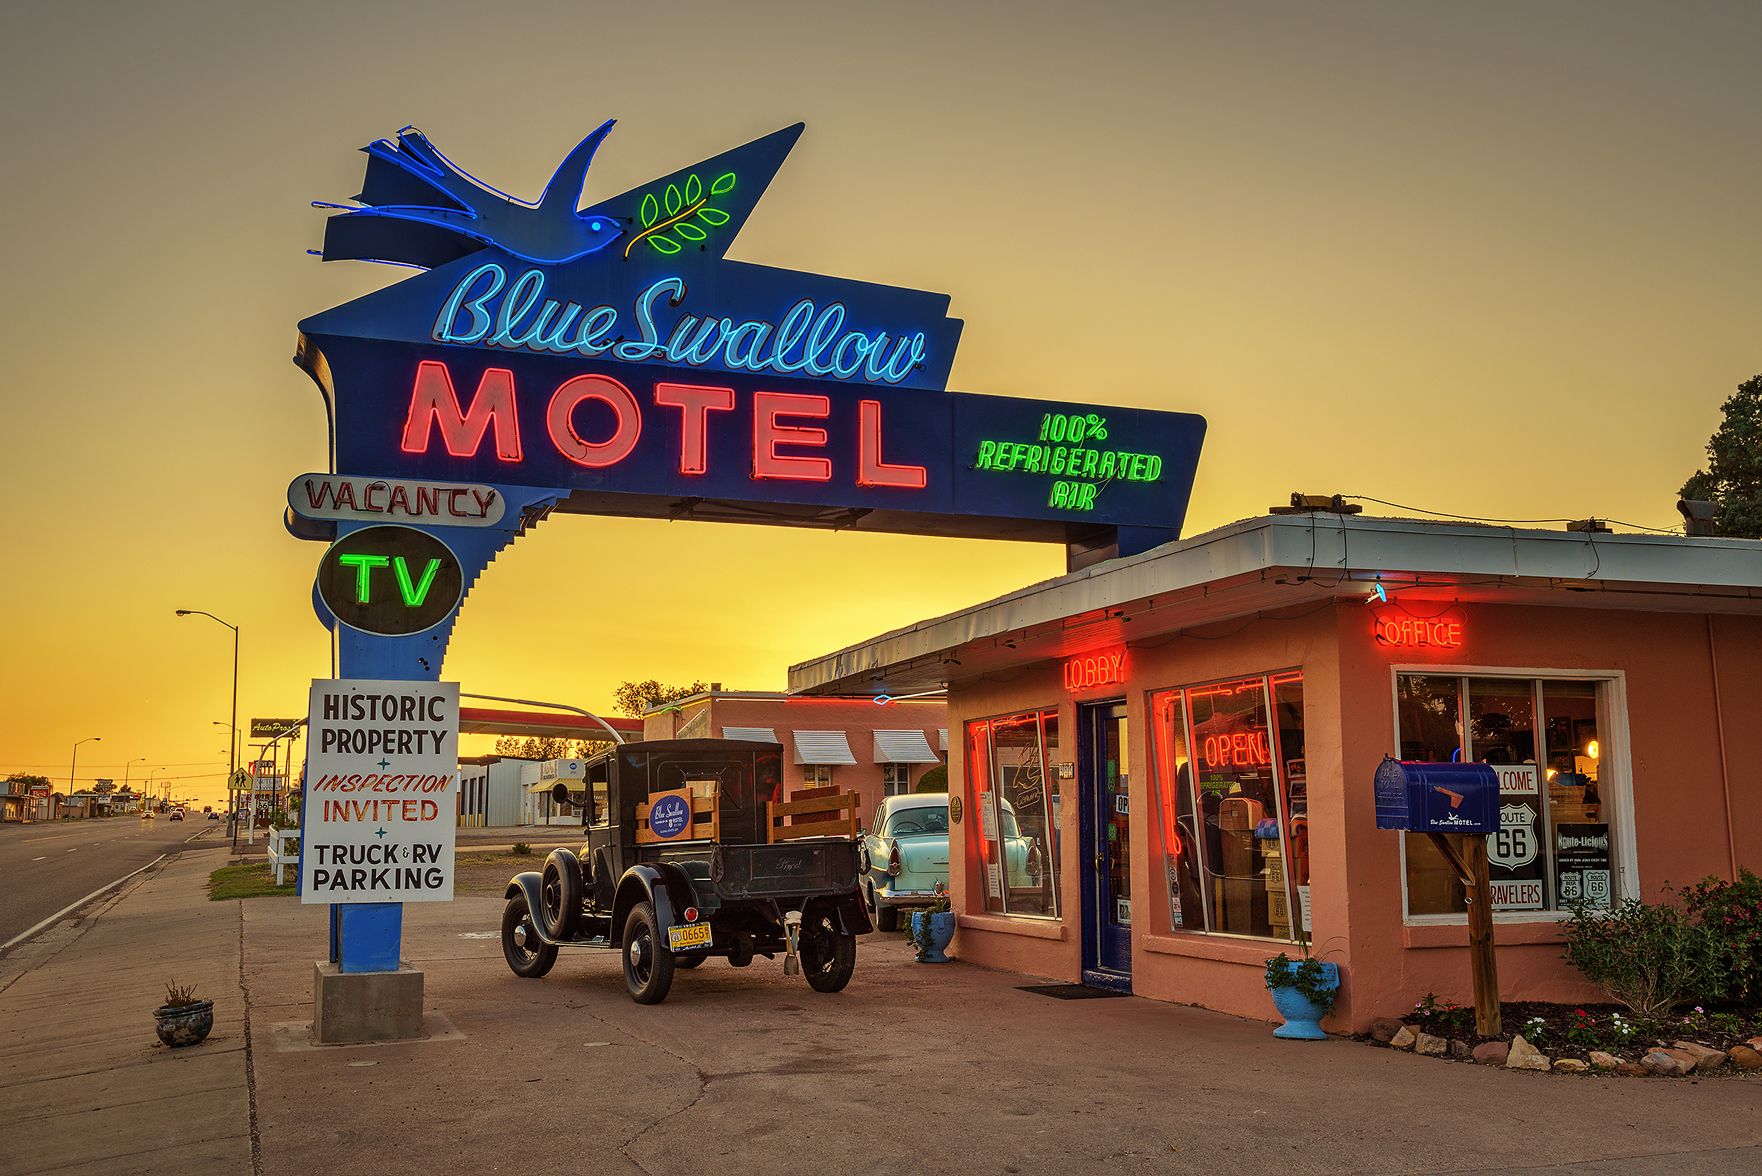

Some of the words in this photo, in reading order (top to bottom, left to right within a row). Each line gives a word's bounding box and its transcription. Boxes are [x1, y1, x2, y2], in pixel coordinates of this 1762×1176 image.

[430, 262, 622, 357] Blue
[610, 276, 926, 385] Swallow
[401, 359, 927, 488] MOTEL
[1037, 412, 1108, 443] 100%
[974, 440, 1163, 482] REFRIGERATED
[304, 478, 497, 518] VACANCY
[1048, 480, 1097, 510] AIR
[339, 553, 442, 607] TV
[1376, 616, 1462, 647] OFFICE
[1064, 653, 1125, 691] LOBBY
[323, 694, 446, 722] HISTORIC
[321, 728, 448, 754] PROPERTY
[1205, 731, 1268, 767] OPEN
[313, 774, 454, 793] INSPECTION
[323, 799, 439, 822] INVITED
[314, 844, 399, 865] TRUCK
[402, 846, 410, 859] &
[412, 843, 443, 864] RV
[1496, 828, 1526, 858] 66
[313, 867, 444, 891] PARKING
[775, 857, 802, 871] Ford
[1591, 882, 1604, 892] 66
[682, 927, 705, 941] 0665
